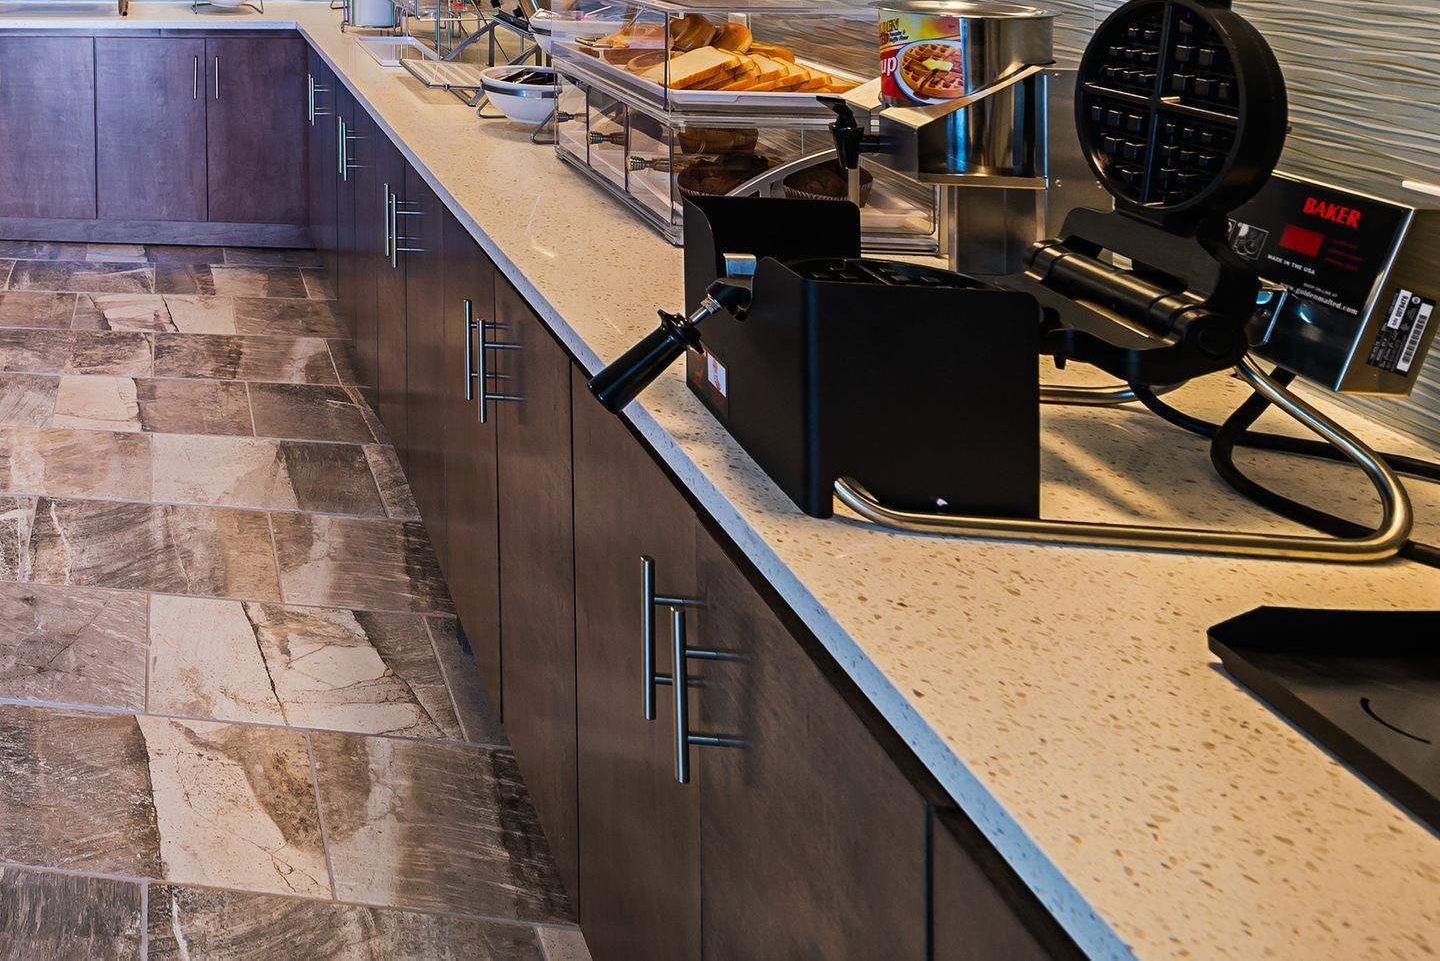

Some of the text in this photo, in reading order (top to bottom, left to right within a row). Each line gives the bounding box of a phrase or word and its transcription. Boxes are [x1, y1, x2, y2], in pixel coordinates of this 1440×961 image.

[1303, 197, 1361, 229] BAKER
[1267, 254, 1316, 275] MADE IN THE USA
